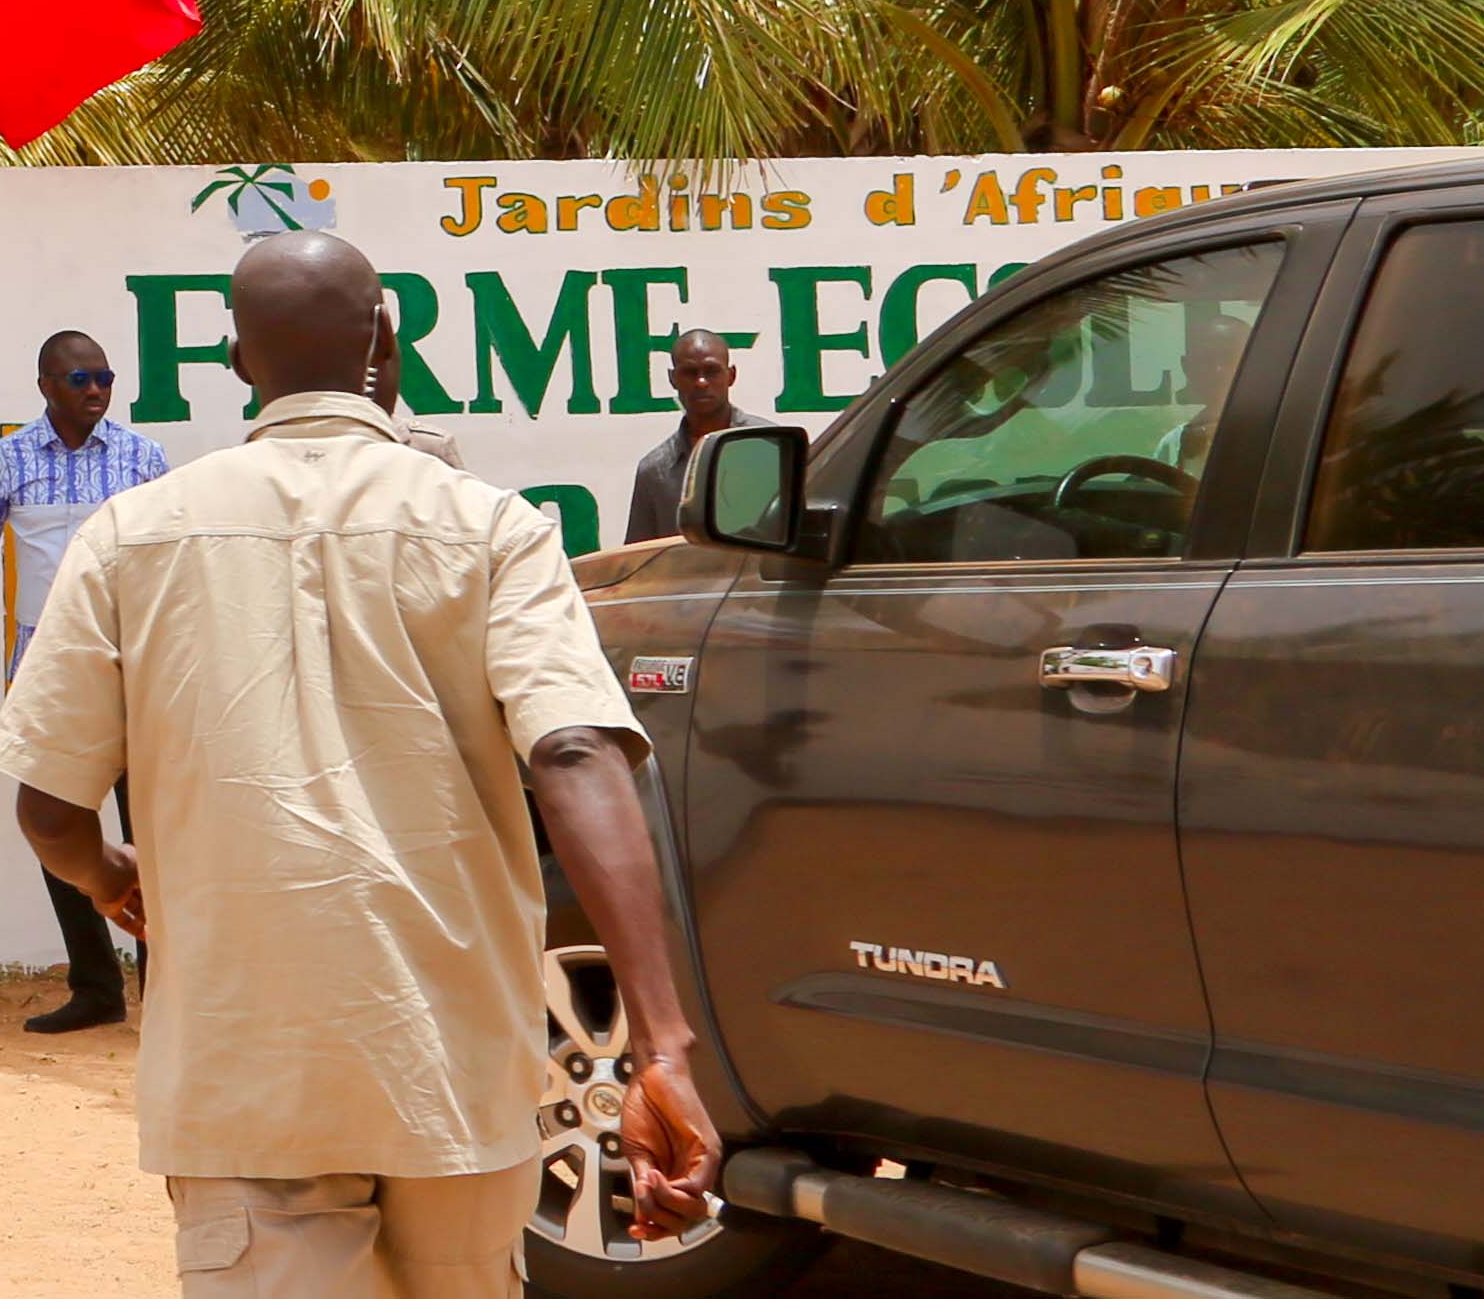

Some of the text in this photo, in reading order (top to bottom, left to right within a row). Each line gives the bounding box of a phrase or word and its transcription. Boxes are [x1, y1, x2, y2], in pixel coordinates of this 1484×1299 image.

[439, 173, 812, 237] Jardins
[665, 665, 684, 687] V8
[850, 940, 1005, 989] TUNDRA
